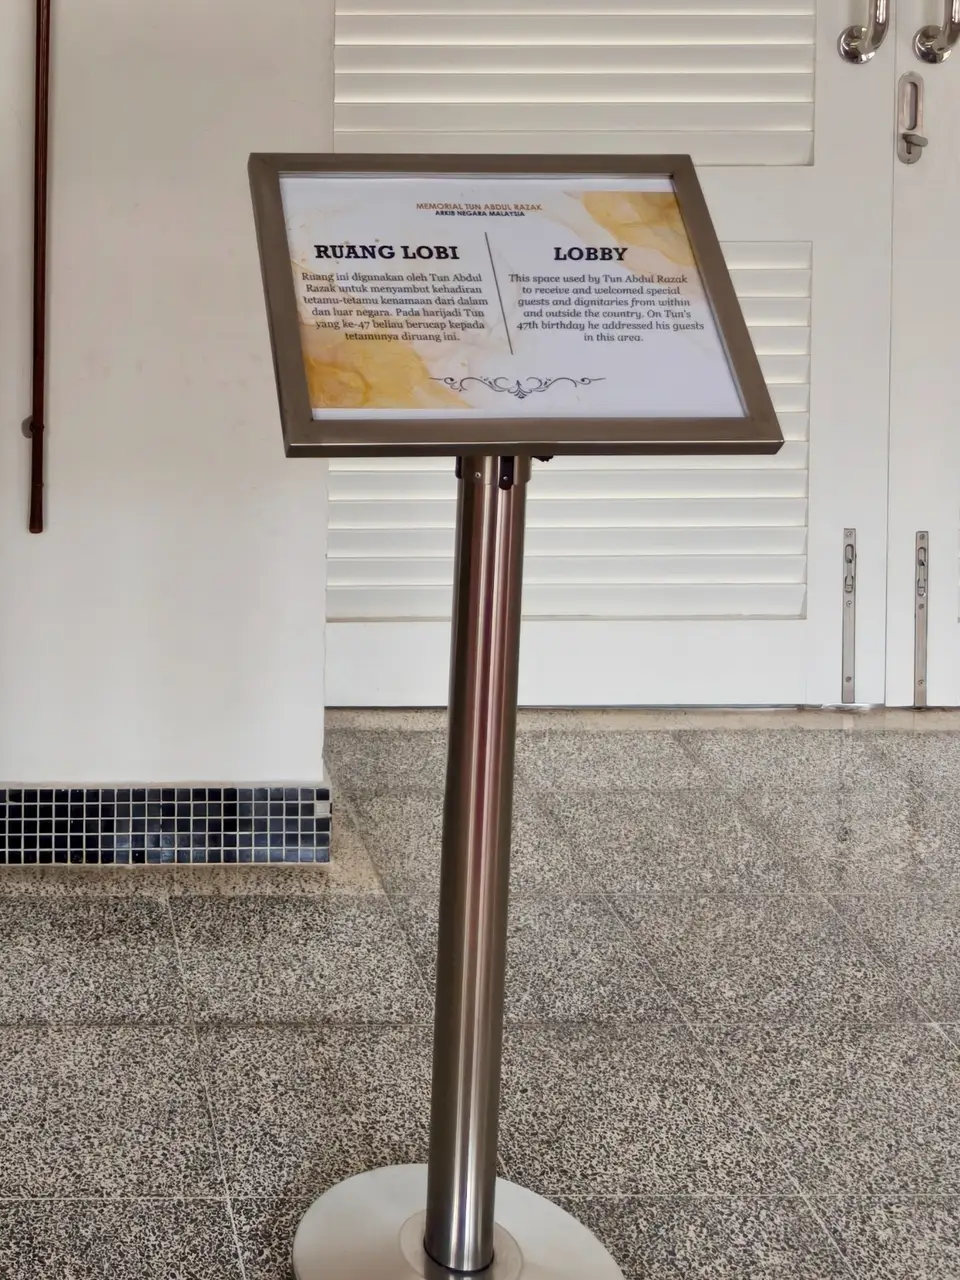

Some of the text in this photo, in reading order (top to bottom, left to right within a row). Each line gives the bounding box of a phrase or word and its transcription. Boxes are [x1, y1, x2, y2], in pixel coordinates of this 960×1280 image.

[464, 203, 482, 211] TUN
[483, 203, 512, 211] ABDUL
[513, 203, 542, 211] RAZAK
[313, 244, 460, 260] RUANG LOBI
[553, 246, 628, 261] LOBBY
[301, 272, 482, 283] Ruang ini digunakan oleh Tun Abdul
[508, 273, 688, 285] This space used by Tun Abdul Razak
[306, 283, 482, 295] Razak untuk menyambut kehadiran
[522, 286, 681, 296] to receive and welcomed special
[303, 296, 489, 306] tetamu-tetamu kenamaan dari dalam
[517, 297, 690, 308] guests and dignitaries from within
[311, 307, 485, 320] dan luar negara. Pada harijadi Tun
[523, 309, 691, 320] and outside the country. On Tun's
[315, 319, 485, 331] yang ke-47 beliau berucap kepada
[516, 321, 705, 331] 47th birthday he addressed his guests
[345, 332, 460, 343] tetamunya diruang ini.
[584, 333, 644, 342] in this area.
